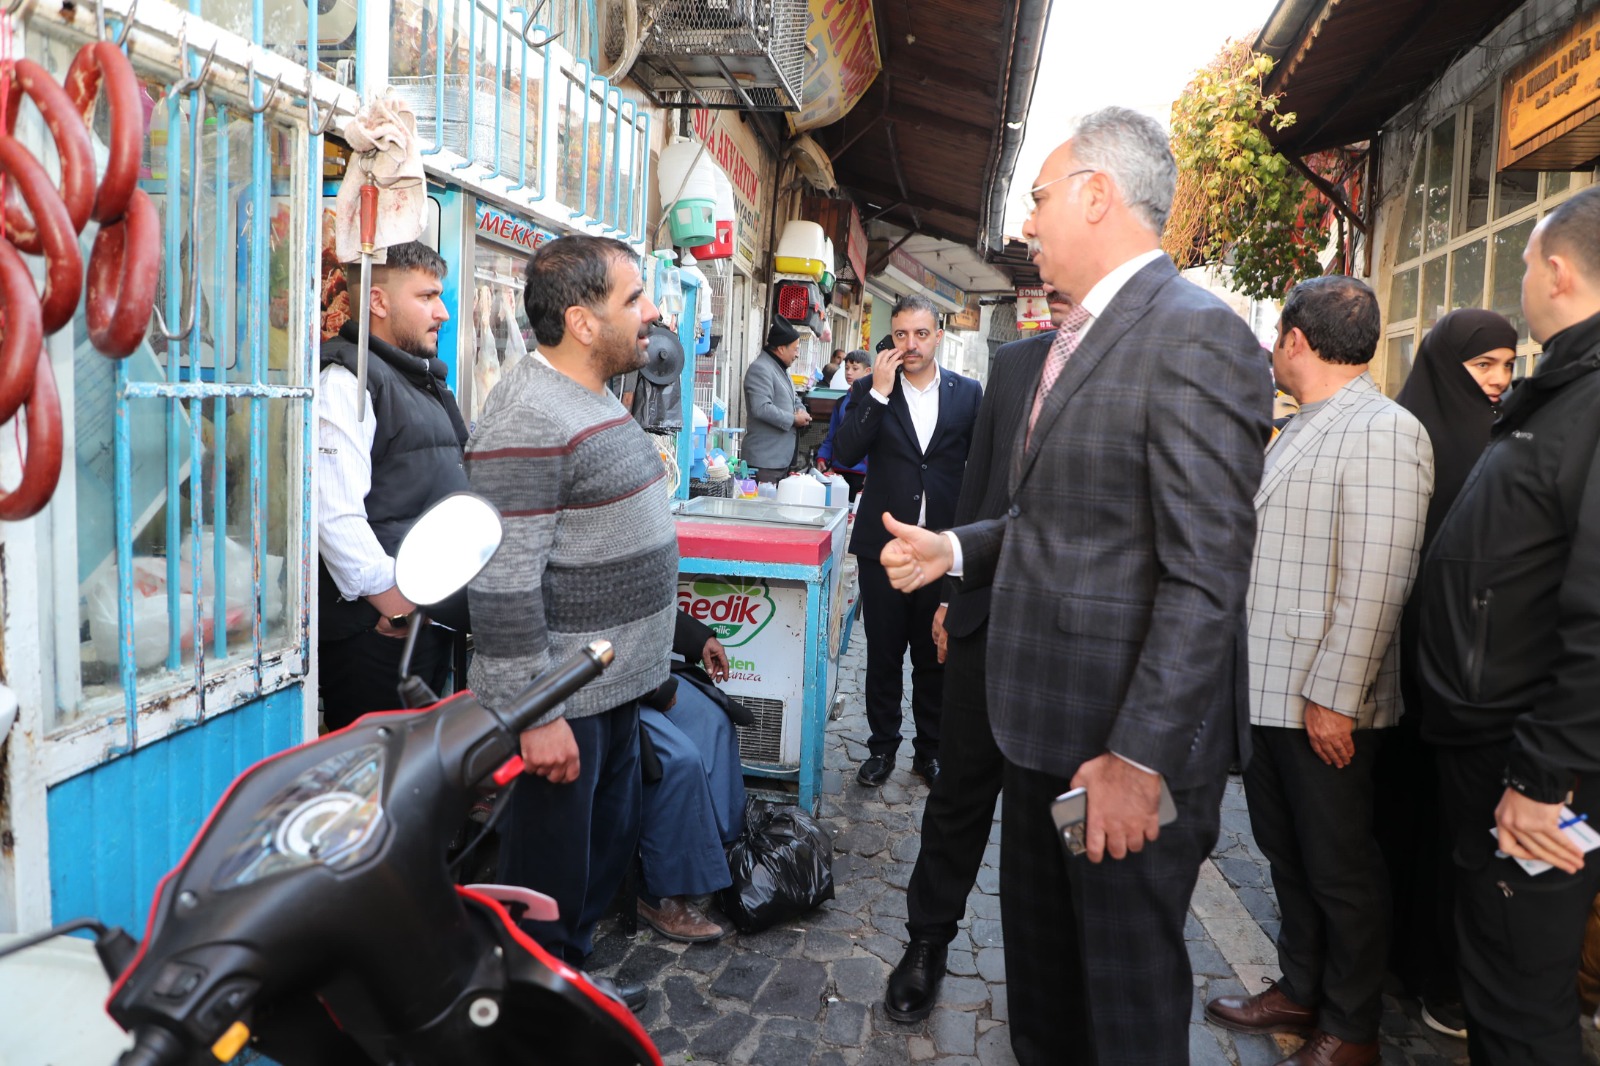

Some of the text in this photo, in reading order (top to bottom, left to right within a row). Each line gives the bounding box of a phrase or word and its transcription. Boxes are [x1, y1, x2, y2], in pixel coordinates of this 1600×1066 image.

[716, 127, 758, 206] AKVARYUM
[732, 187, 754, 229] NYASI
[479, 212, 544, 250] MEKKE
